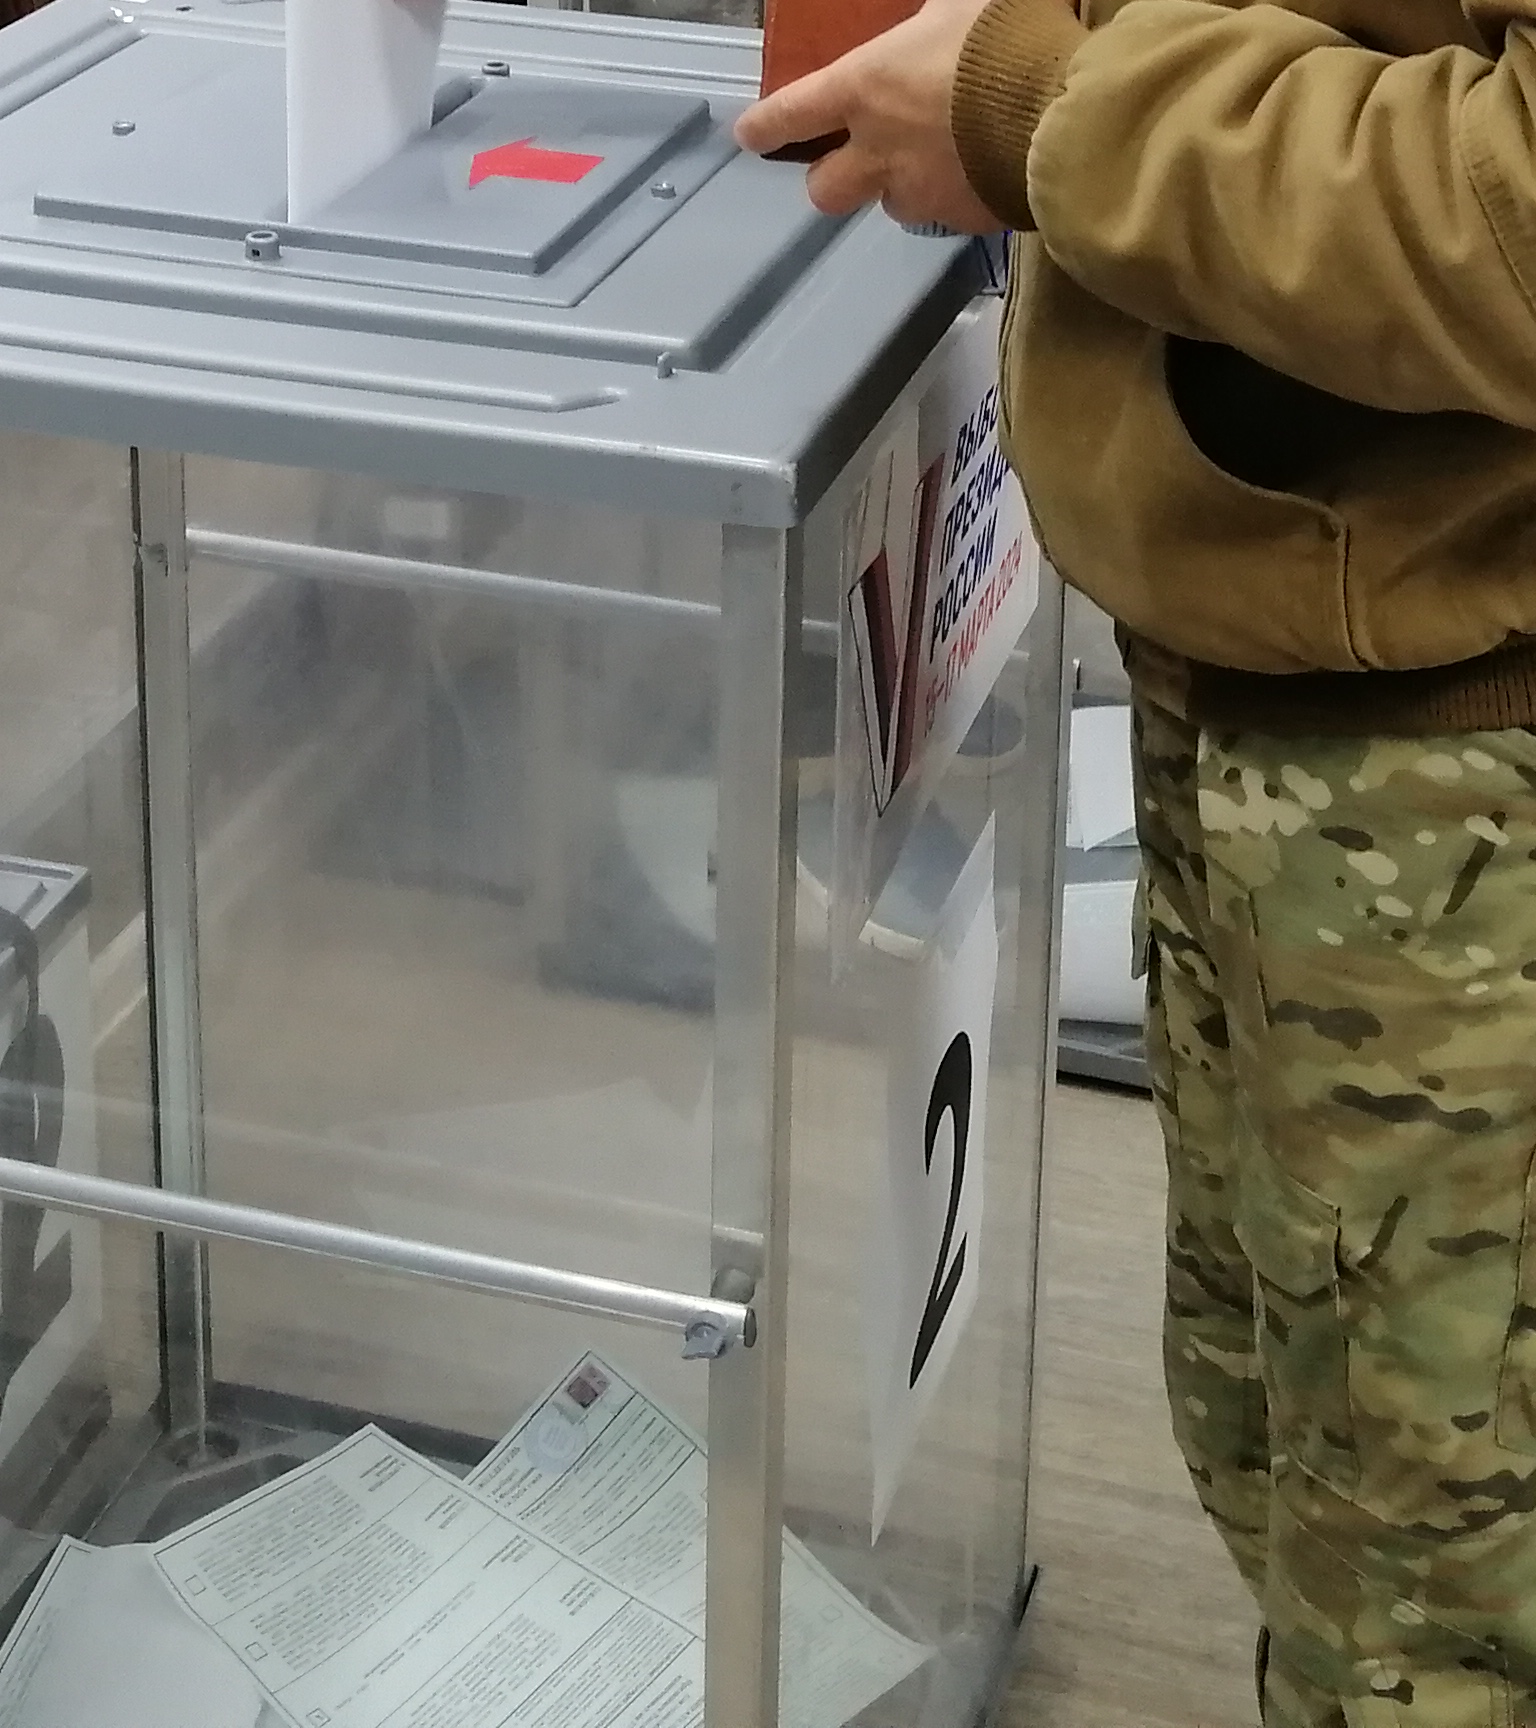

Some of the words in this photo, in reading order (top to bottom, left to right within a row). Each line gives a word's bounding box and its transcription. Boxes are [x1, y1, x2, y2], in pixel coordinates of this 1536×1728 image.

[939, 443, 1011, 575] ПРЕЗИД
[929, 508, 999, 665] РОССИИ
[957, 576, 996, 680] МАРТА
[908, 1029, 973, 1391] 2
